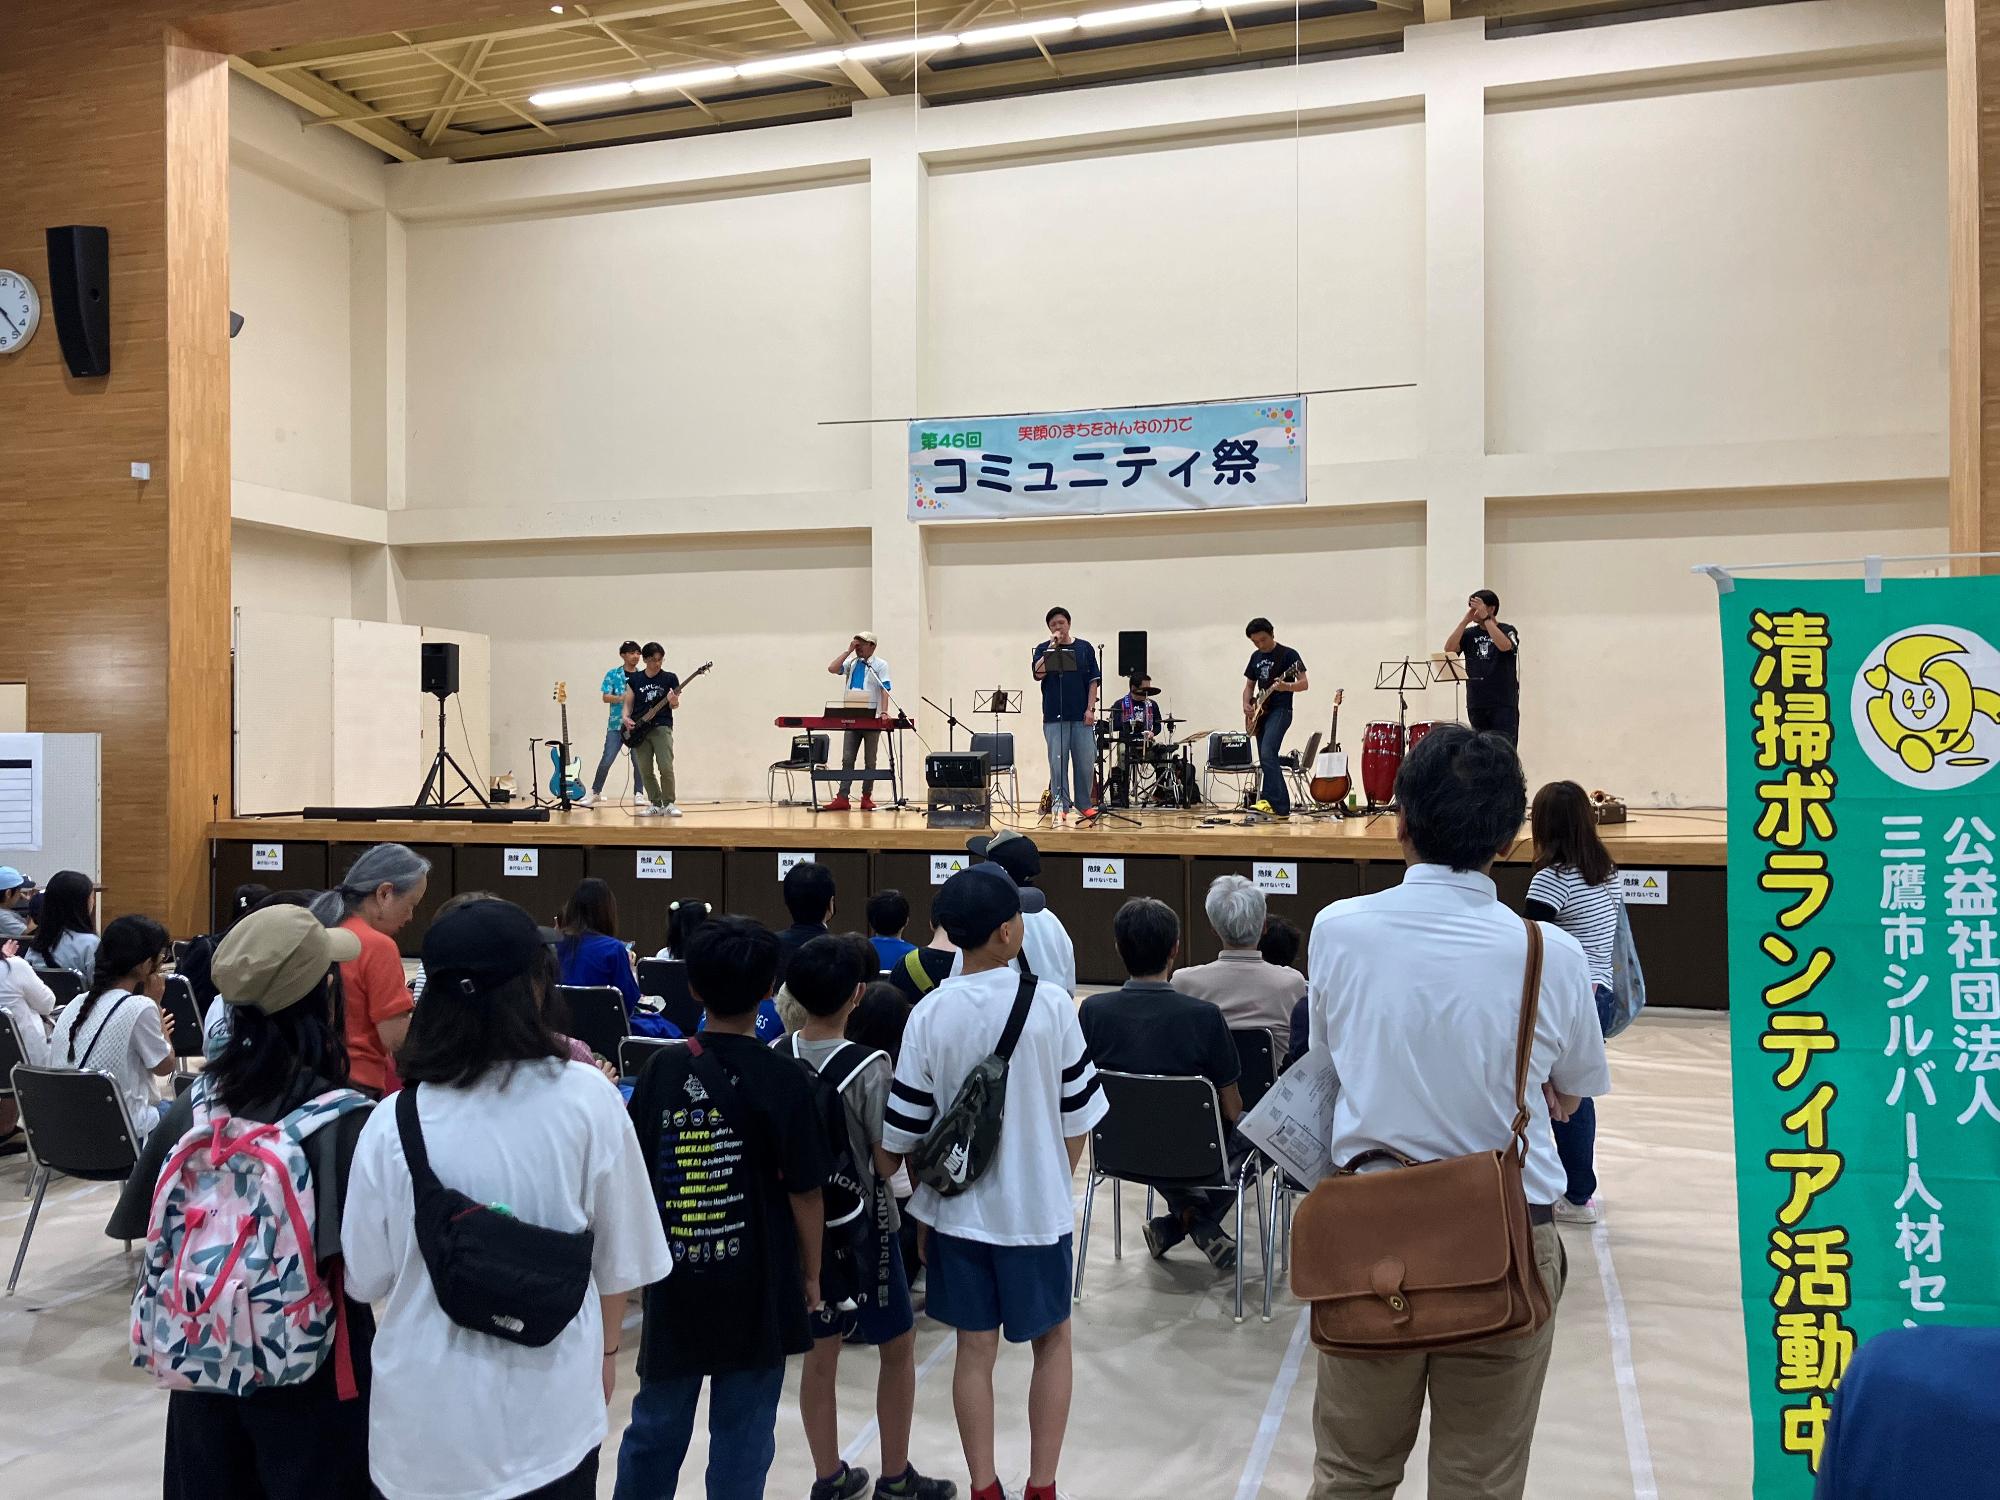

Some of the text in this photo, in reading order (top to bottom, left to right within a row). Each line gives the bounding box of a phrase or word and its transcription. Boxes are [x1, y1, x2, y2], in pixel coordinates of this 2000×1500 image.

[19, 290, 26, 299] 2
[22, 305, 30, 313] 3
[920, 431, 982, 450] 第46回
[1018, 416, 1193, 442] 笑顔のまちをみんなの力で
[933, 438, 1260, 494] コミュニティ祭
[1936, 728, 1959, 744] T
[1943, 815, 2000, 1125] 公益社団法人
[1879, 815, 1947, 1329] 三鷹市シルバー人材セ
[943, 1142, 965, 1175] NIKE
